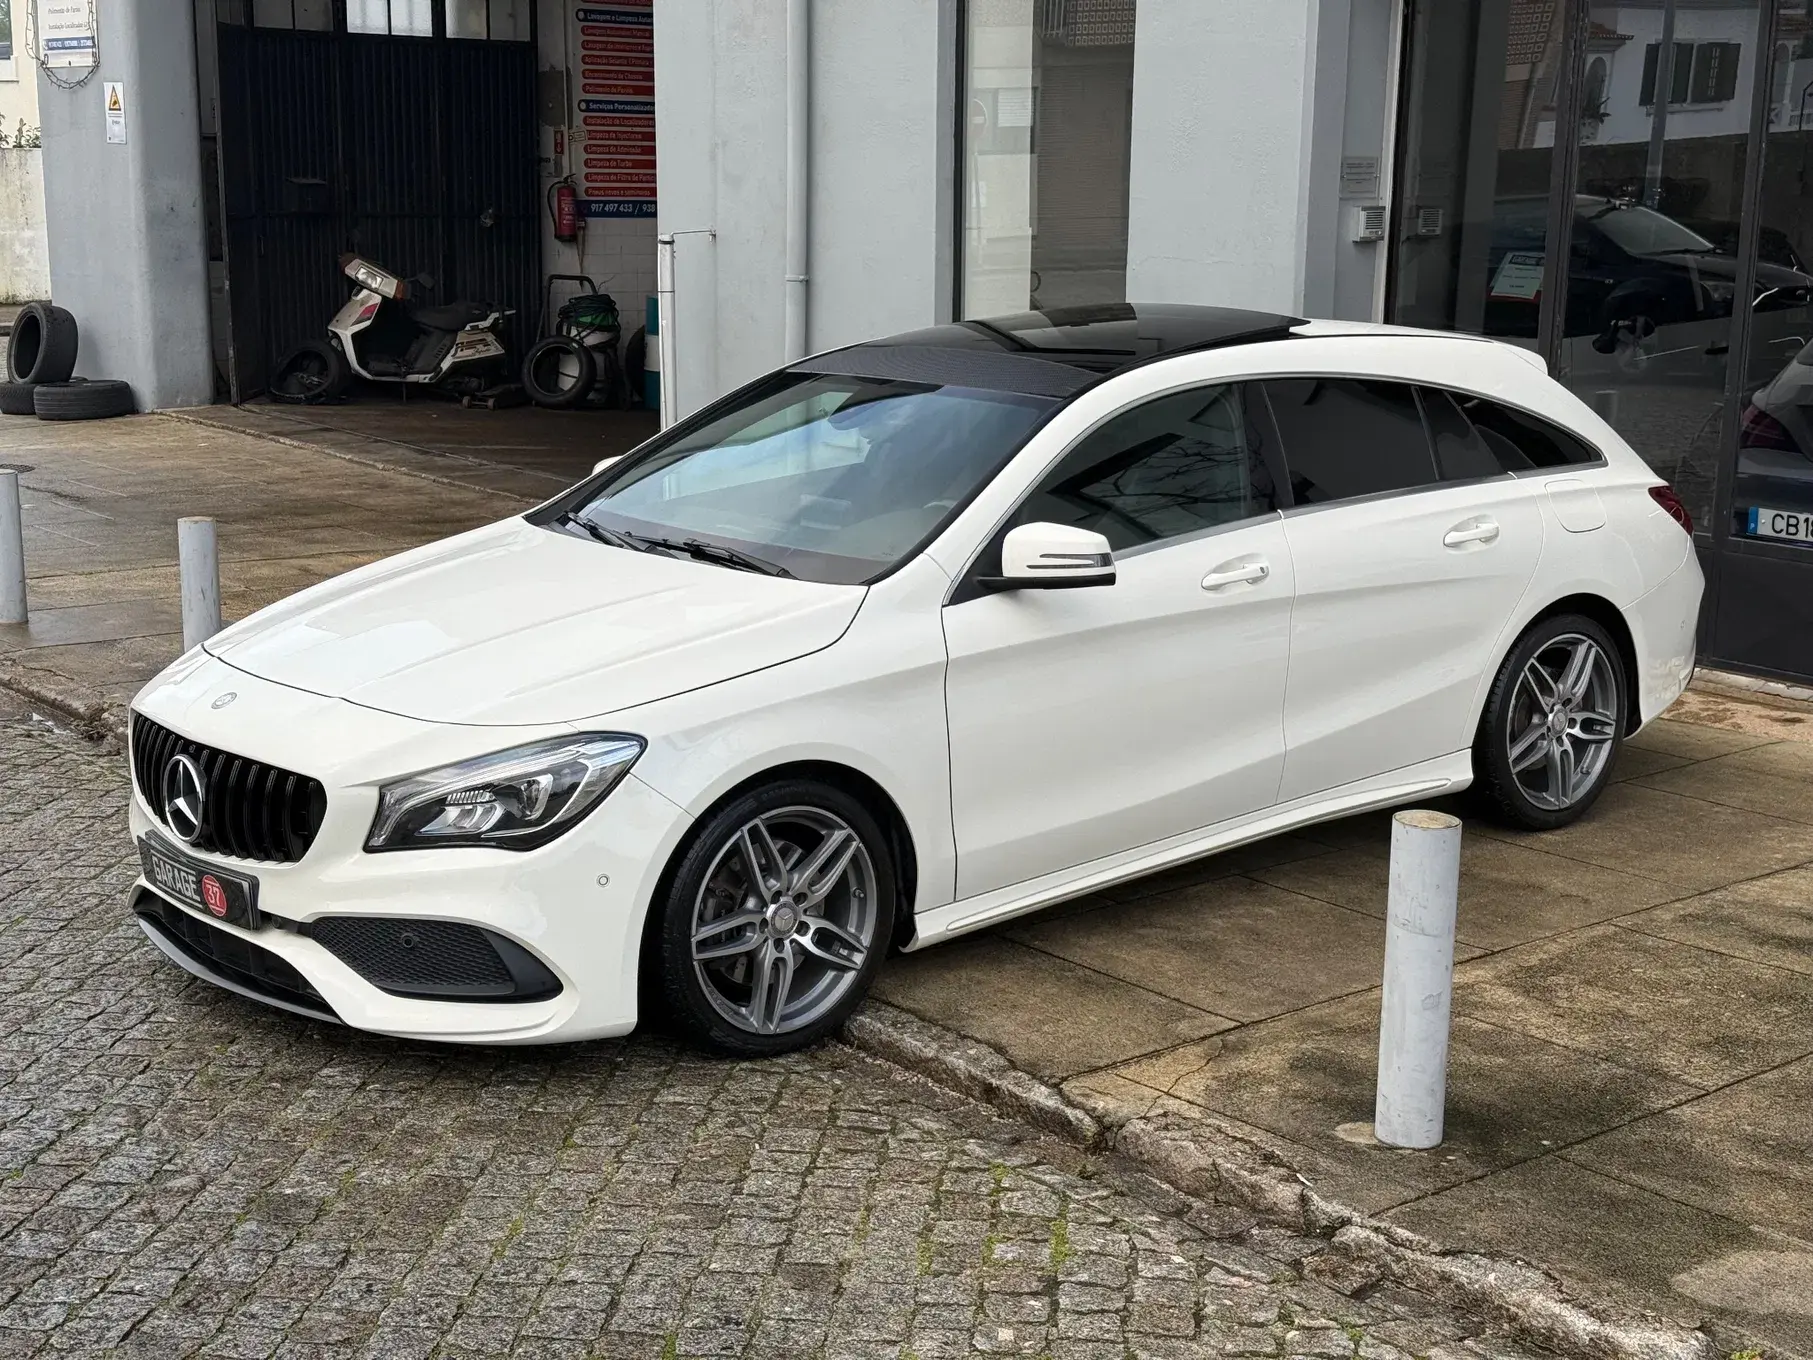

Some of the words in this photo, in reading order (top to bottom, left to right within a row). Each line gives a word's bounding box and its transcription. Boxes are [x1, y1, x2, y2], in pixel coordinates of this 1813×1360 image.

[587, 12, 610, 21] Lavagem
[616, 14, 637, 23] Limpeza
[589, 102, 613, 110] Serviços
[587, 117, 613, 125] Instalação
[617, 160, 632, 168] Turbo
[588, 173, 609, 181] Limpeza
[588, 188, 604, 196] Pneus
[590, 203, 603, 212] 917
[604, 203, 618, 212] 497
[619, 203, 633, 212] 433
[642, 203, 656, 212] 938
[151, 854, 201, 902] GARAGE
[205, 884, 221, 907] 37
